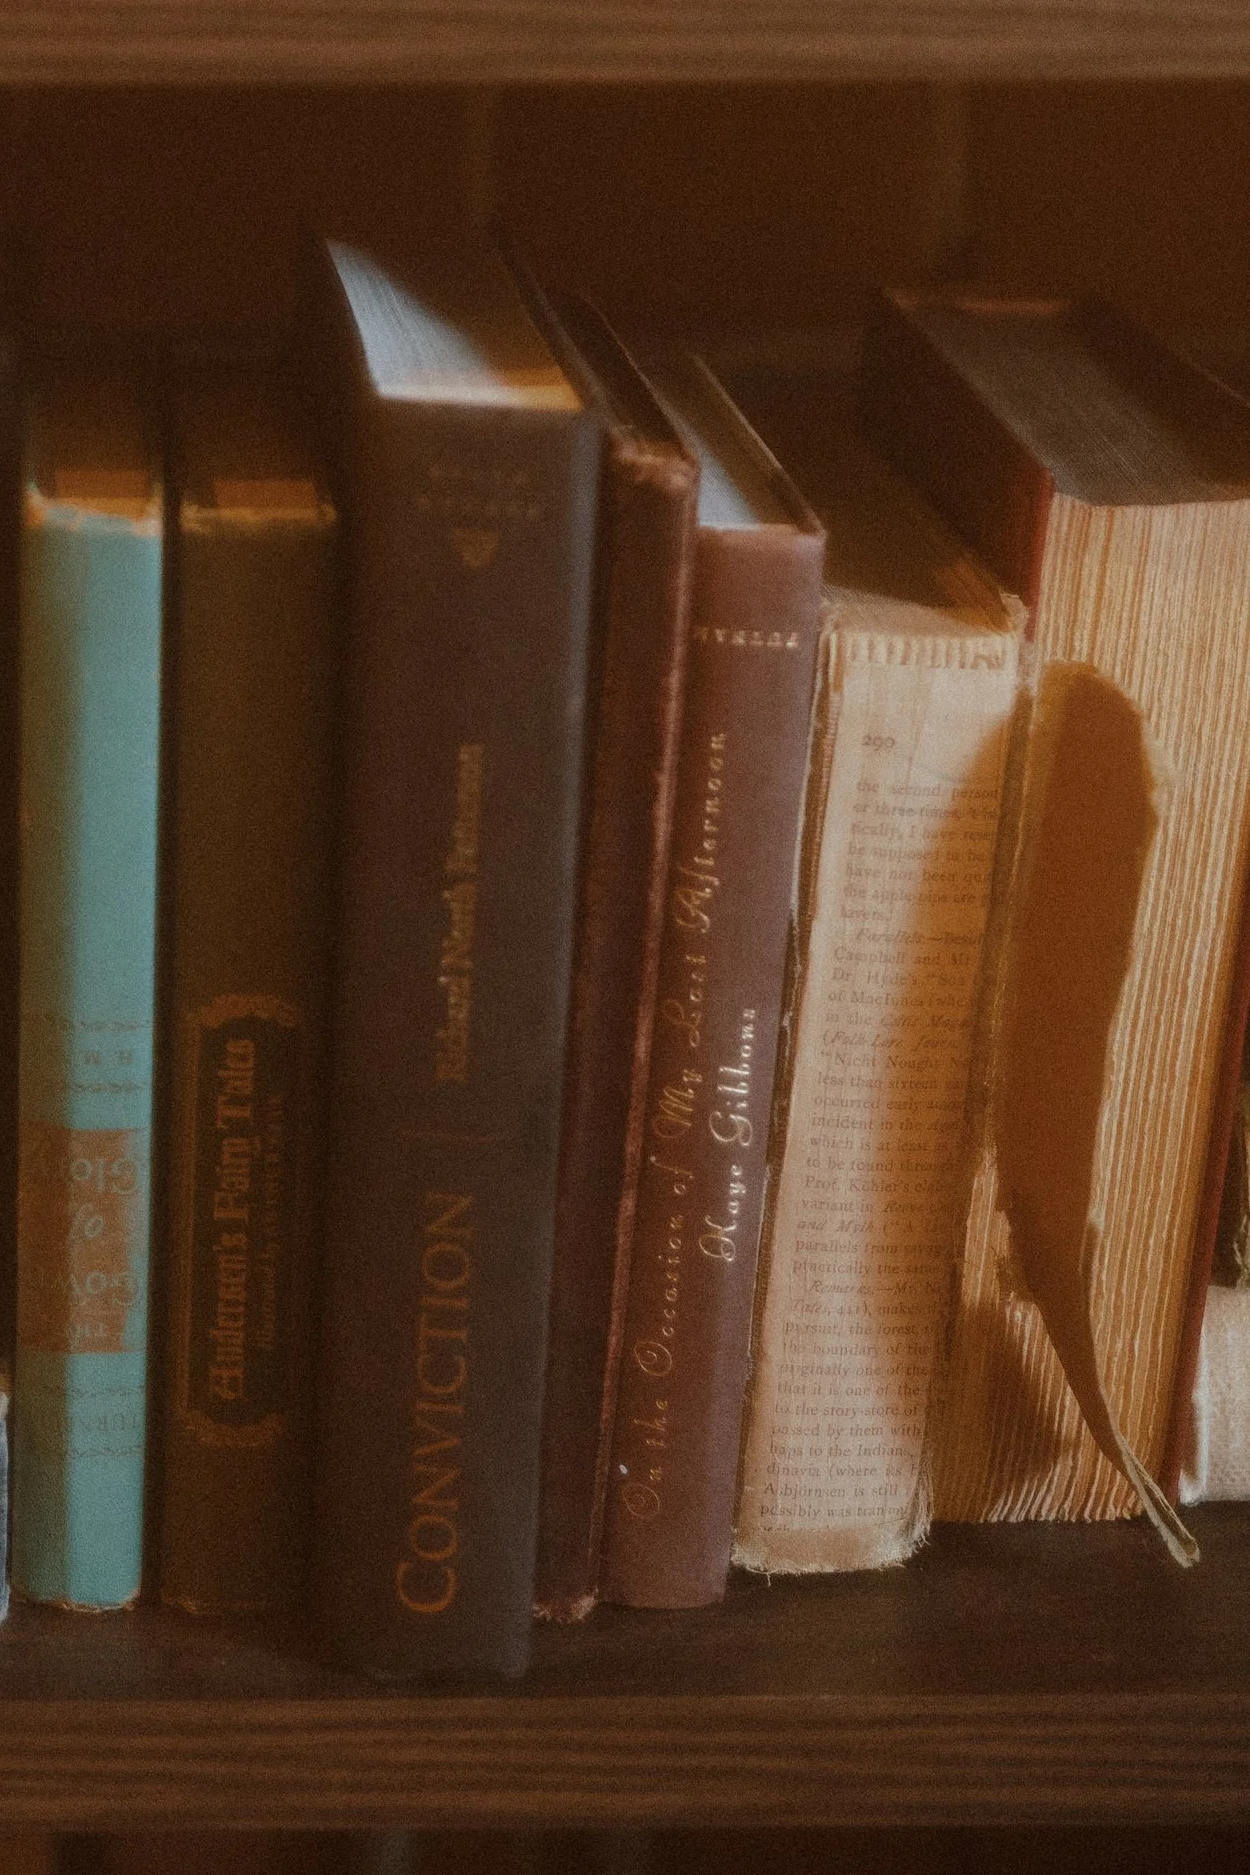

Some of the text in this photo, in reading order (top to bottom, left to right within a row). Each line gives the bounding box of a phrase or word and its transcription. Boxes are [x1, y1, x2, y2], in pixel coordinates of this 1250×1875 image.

[696, 625, 799, 649] PUTNAM
[862, 734, 897, 752] 290
[857, 781, 879, 792] the
[890, 784, 941, 796] second
[873, 847, 940, 863] supposed
[846, 863, 881, 878] have
[922, 870, 956, 882] been
[441, 882, 476, 969] North
[834, 946, 907, 964] Campbell
[913, 953, 941, 965] and
[828, 990, 845, 1002] of
[436, 974, 471, 1081] Richard
[817, 1071, 844, 1086] less
[850, 1076, 882, 1089] than
[888, 1076, 938, 1089] sixteen
[814, 1097, 880, 1110] occurred
[886, 1099, 921, 1114] early
[622, 733, 726, 1520] On the Occasion of My Last Afternoon
[812, 1112, 874, 1130] incident
[899, 1117, 922, 1131] the
[698, 1008, 757, 1264] Kaye Gibbons
[810, 1134, 853, 1150] which
[860, 1139, 871, 1151] is
[897, 1139, 929, 1152] least
[806, 1156, 821, 1168] to
[828, 1156, 845, 1170] be
[850, 1160, 894, 1172] found
[801, 1199, 854, 1213] variant
[209, 1039, 262, 1401] Andersen's Fairy Tales
[797, 1219, 827, 1231] and
[795, 1239, 858, 1254] parallels
[864, 1241, 899, 1255] from
[793, 1260, 871, 1276] practically
[877, 1264, 900, 1274] the
[784, 1323, 841, 1336] pursuit,
[849, 1323, 872, 1335] the
[812, 1343, 879, 1358] boundary
[886, 1343, 902, 1355] of
[780, 1363, 928, 1379] originally one of the
[778, 1381, 920, 1397] that it is one of the
[395, 1188, 475, 1615] CONVICTION
[795, 1402, 818, 1416] the
[771, 1424, 820, 1439] passed
[827, 1423, 845, 1440] by
[849, 1426, 883, 1437] them
[769, 1443, 803, 1460] haps
[809, 1445, 823, 1457] to
[828, 1444, 851, 1457] the
[766, 1462, 821, 1477] dinavia
[828, 1465, 878, 1479] (where
[854, 1486, 865, 1497] is
[871, 1485, 898, 1497] still
[760, 1503, 821, 1519] possibly
